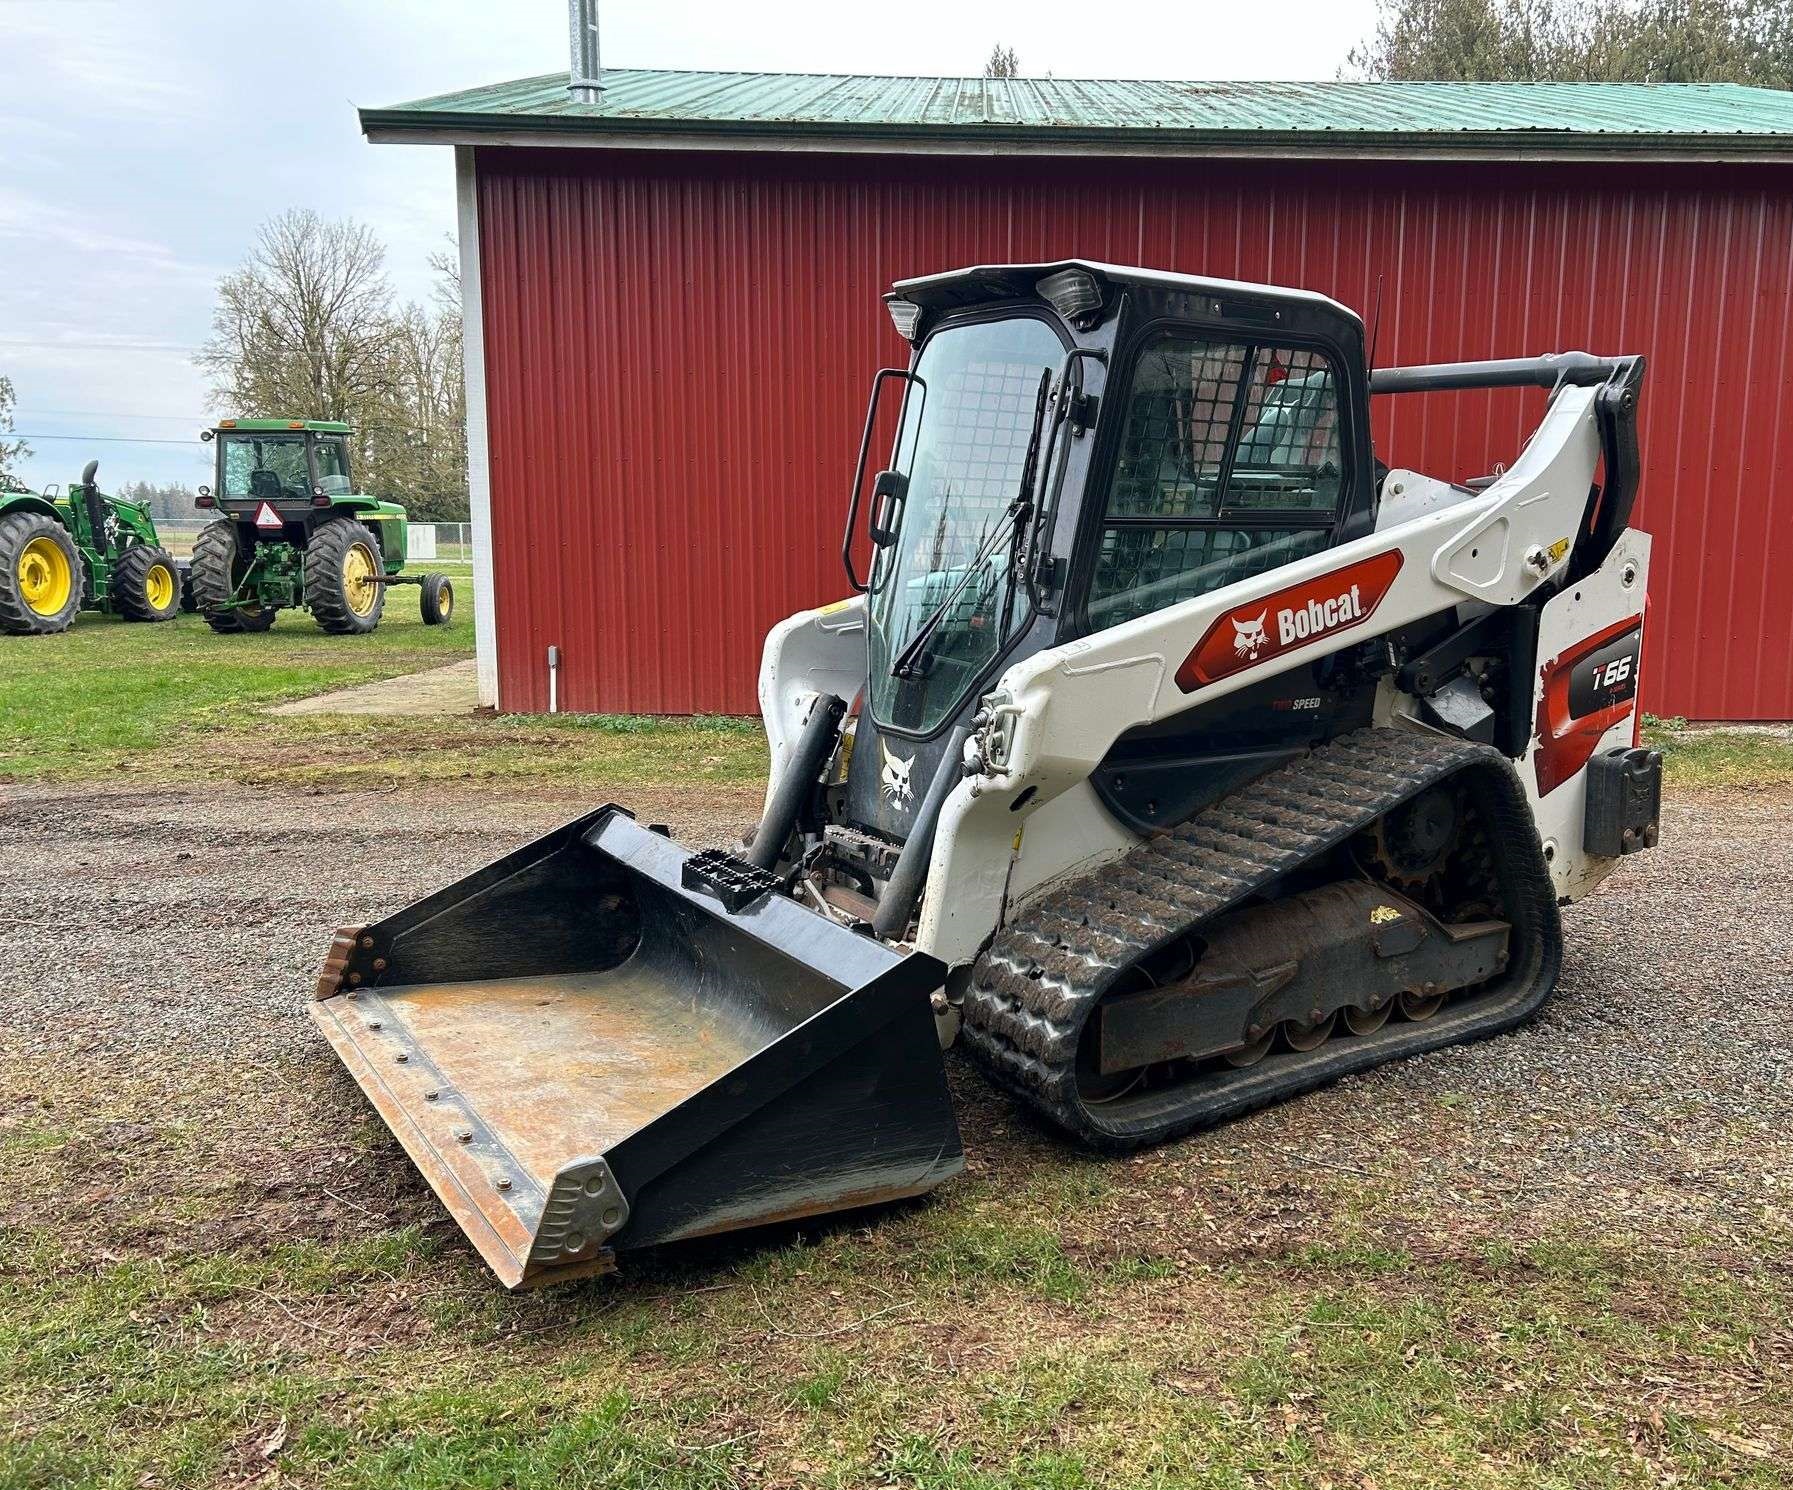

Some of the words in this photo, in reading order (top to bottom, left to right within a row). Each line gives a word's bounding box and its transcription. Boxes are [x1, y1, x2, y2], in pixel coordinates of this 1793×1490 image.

[1278, 584, 1361, 646] Bobcat
[1593, 655, 1632, 690] T66
[1293, 698, 1320, 710] SPEED
